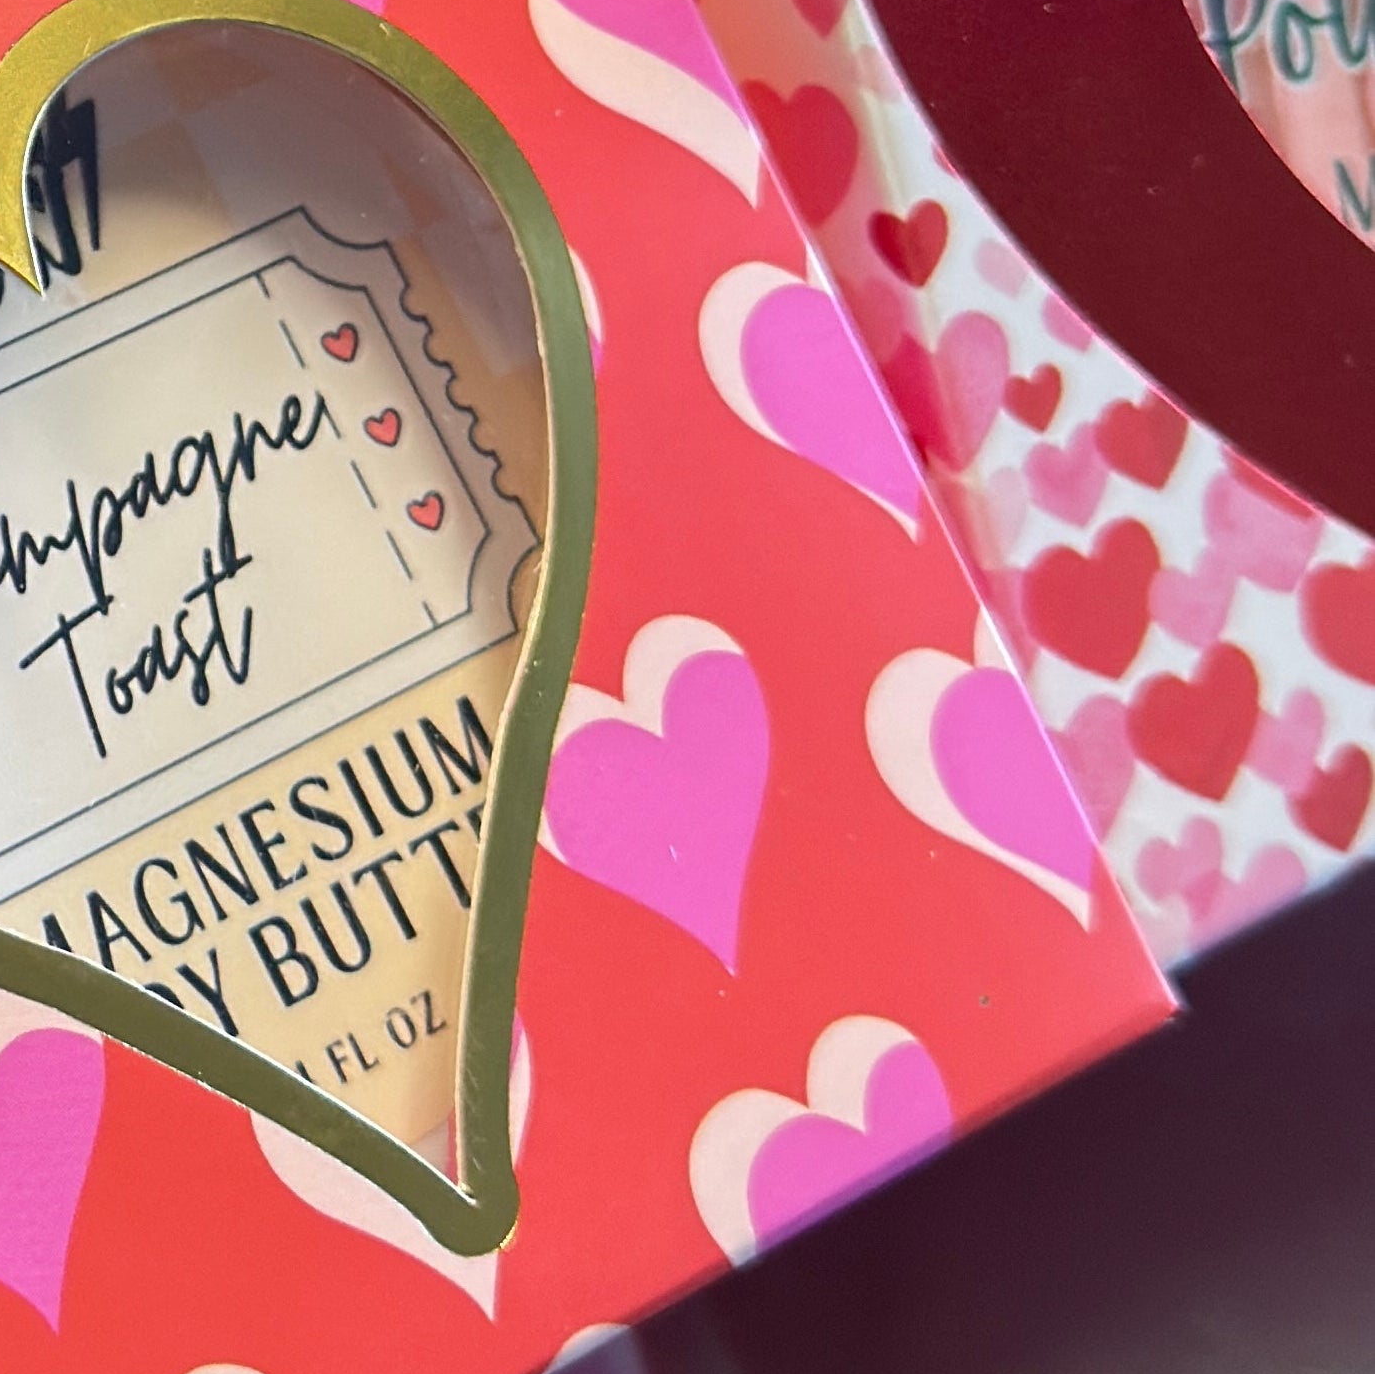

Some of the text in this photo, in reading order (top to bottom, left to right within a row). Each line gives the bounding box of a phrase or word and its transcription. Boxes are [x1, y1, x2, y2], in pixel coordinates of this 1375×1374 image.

[18, 547, 253, 758] Toast
[248, 800, 488, 1008] BUTT
[384, 989, 448, 1050] OZ
